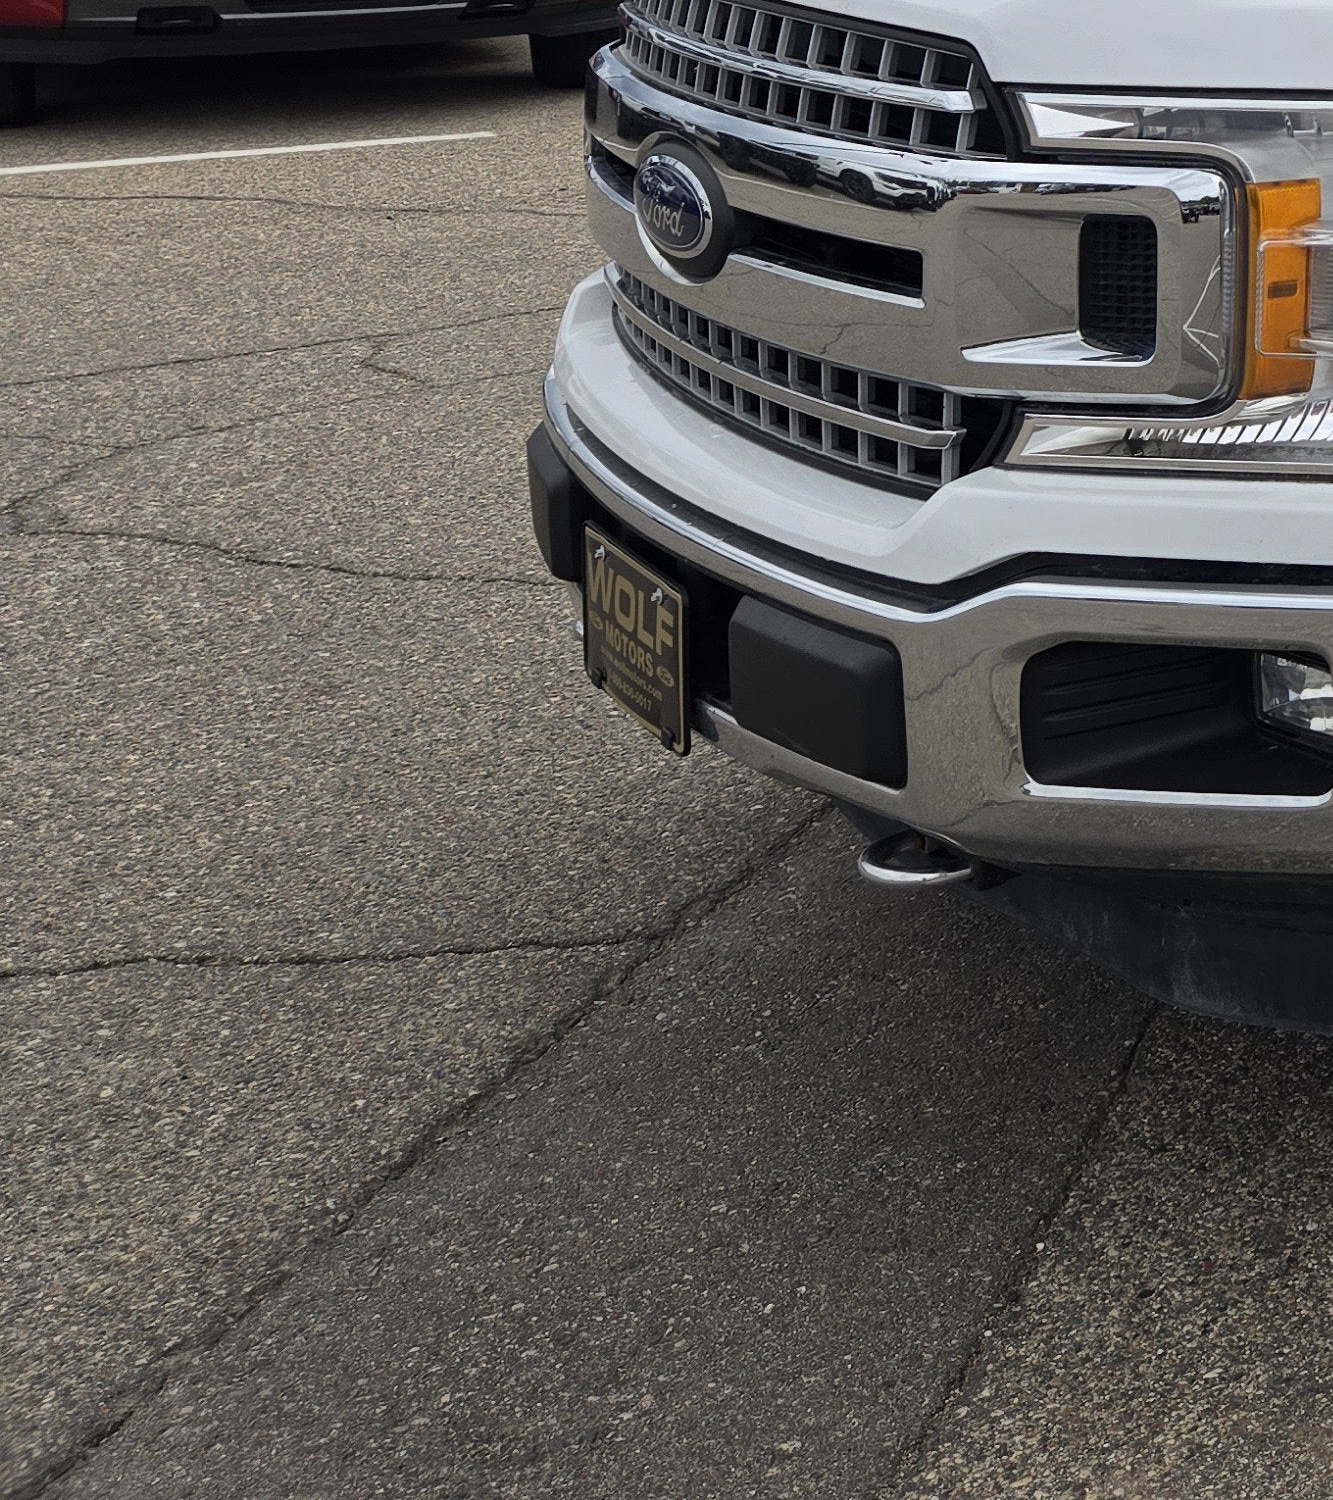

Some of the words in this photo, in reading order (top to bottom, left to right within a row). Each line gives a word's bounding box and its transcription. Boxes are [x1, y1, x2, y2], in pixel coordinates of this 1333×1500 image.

[642, 171, 685, 238] Ford
[587, 552, 674, 656] WOLF
[605, 619, 654, 678] MOTORS
